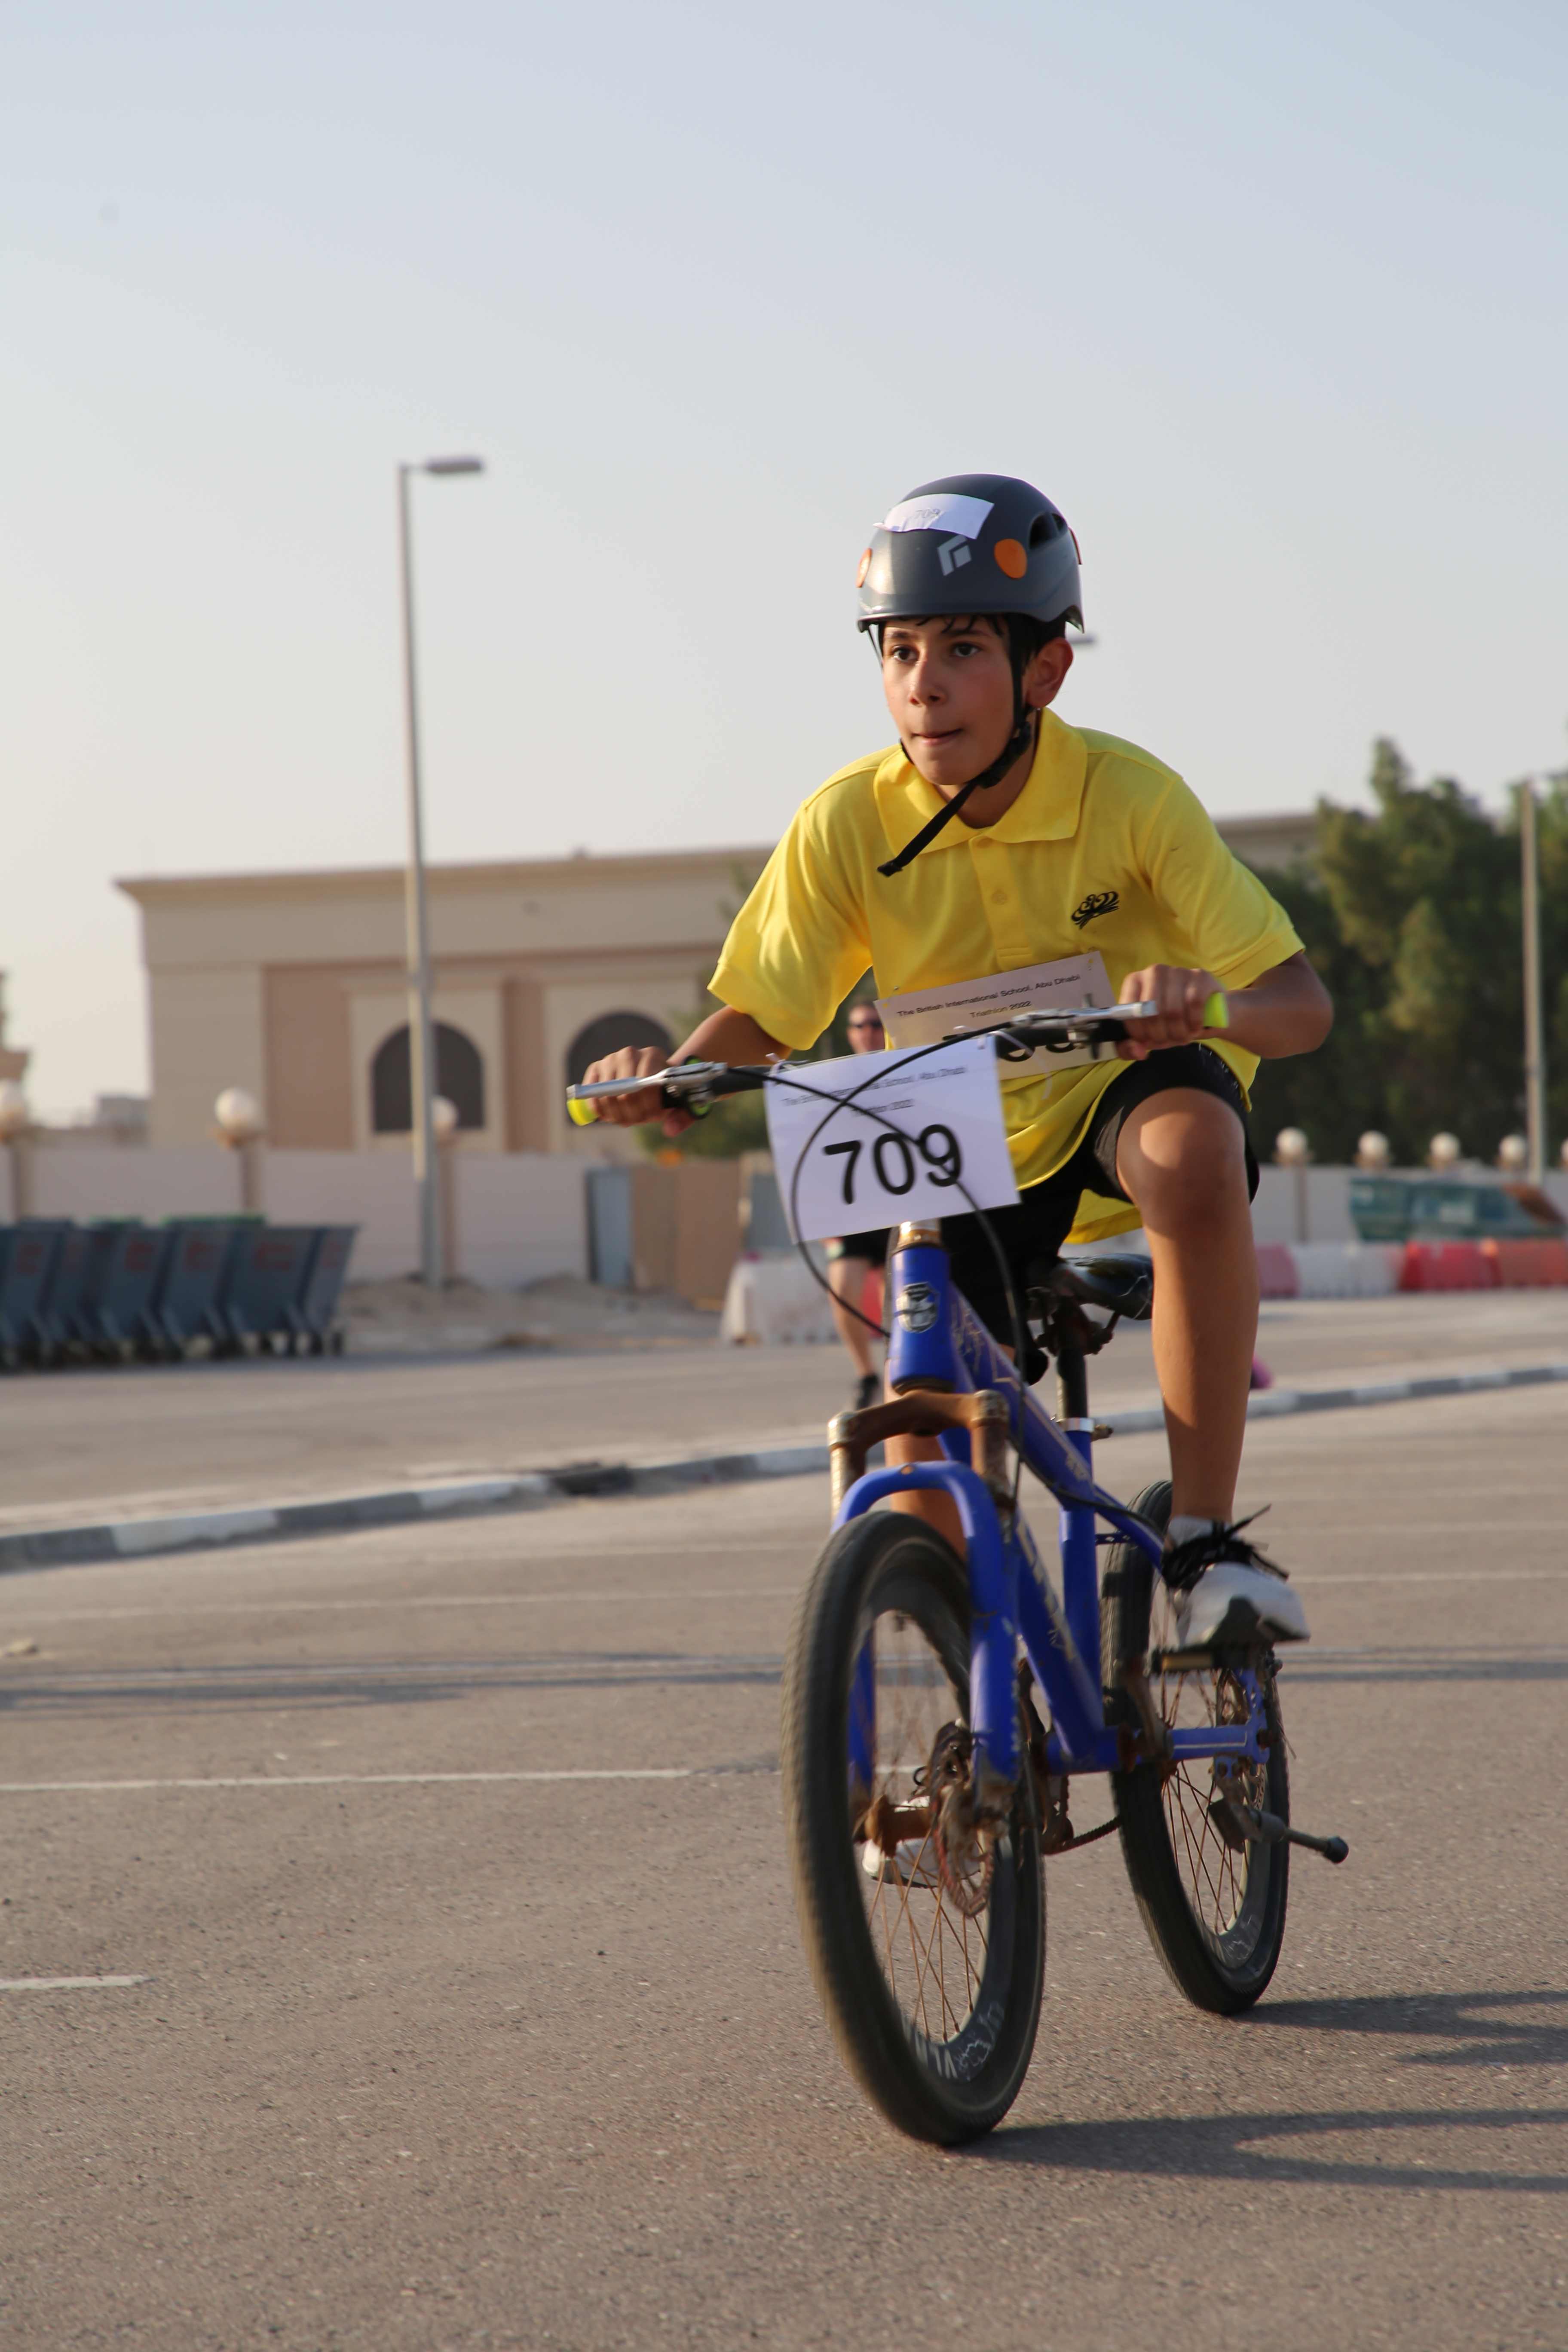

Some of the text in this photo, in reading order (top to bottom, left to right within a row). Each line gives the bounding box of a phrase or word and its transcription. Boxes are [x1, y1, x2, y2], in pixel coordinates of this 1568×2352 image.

[915, 508, 941, 520] 709
[916, 1004, 944, 1014] British
[945, 992, 998, 1008] International
[1054, 974, 1081, 985] Dhabi
[969, 1001, 1032, 1018] Triathlon 2022
[823, 1124, 962, 1205] 709
